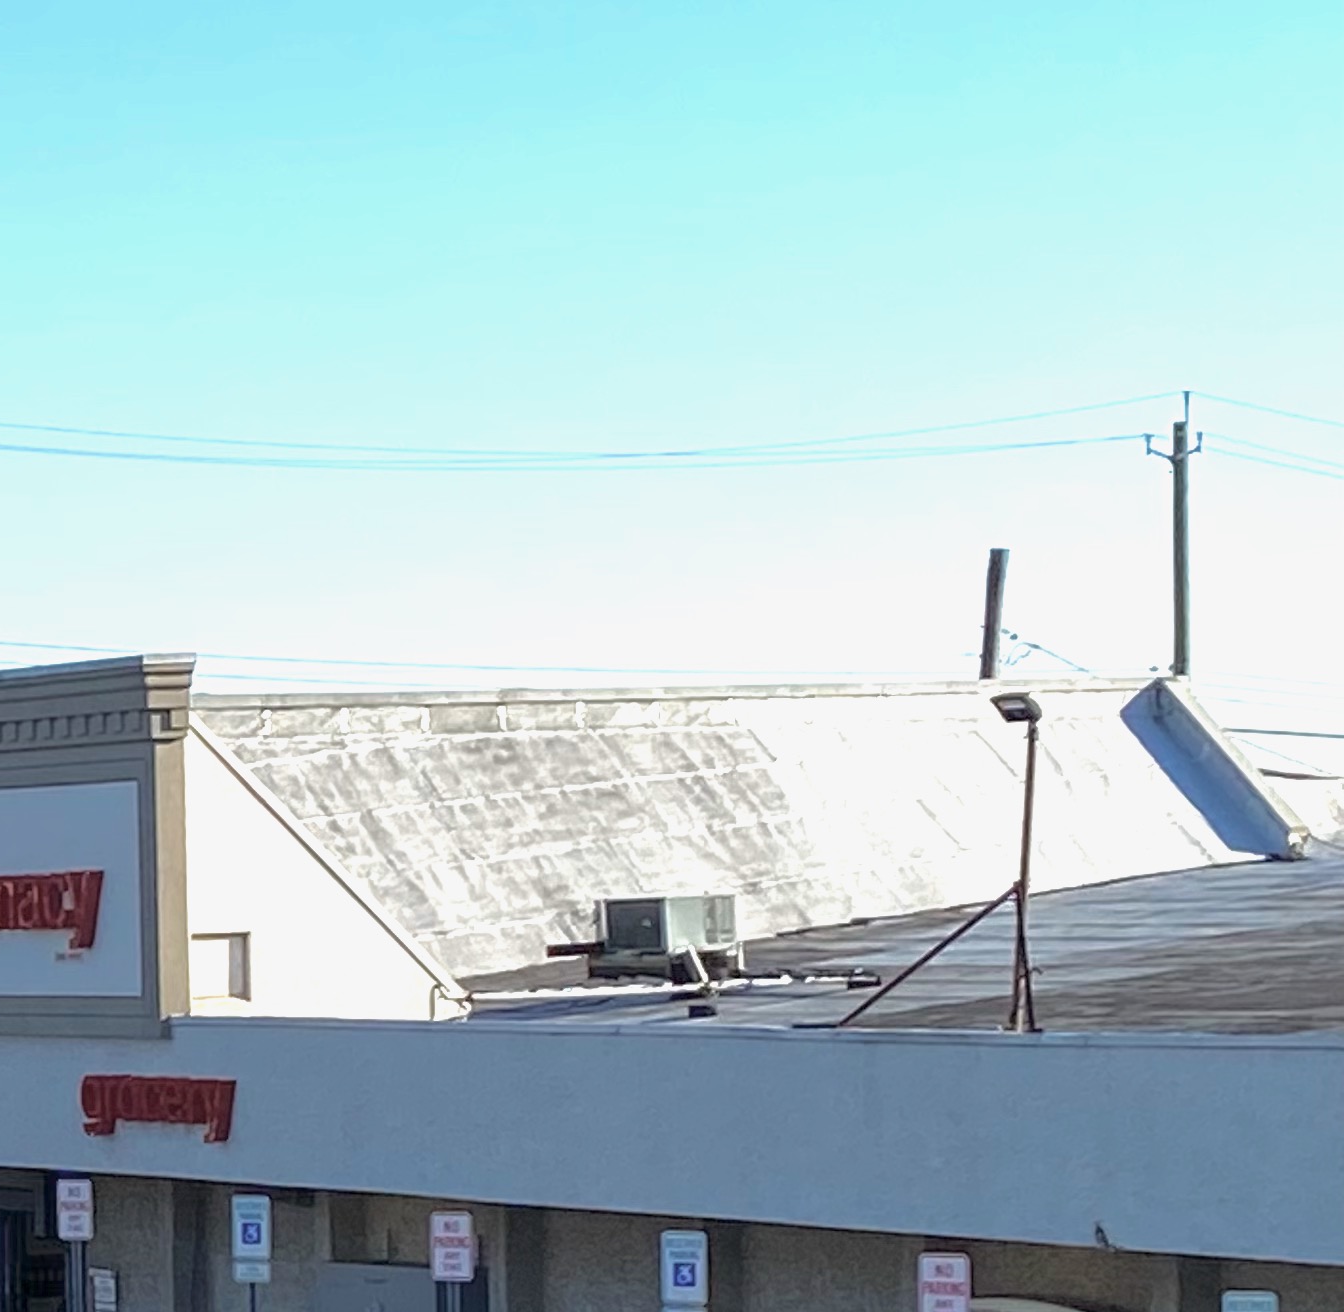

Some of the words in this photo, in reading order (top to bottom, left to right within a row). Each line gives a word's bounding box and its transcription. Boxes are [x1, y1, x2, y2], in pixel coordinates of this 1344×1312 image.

[80, 1074, 237, 1144] grocery
[443, 1220, 460, 1233] NO
[934, 1263, 954, 1277] NO
[921, 1282, 965, 1295] PARKING
